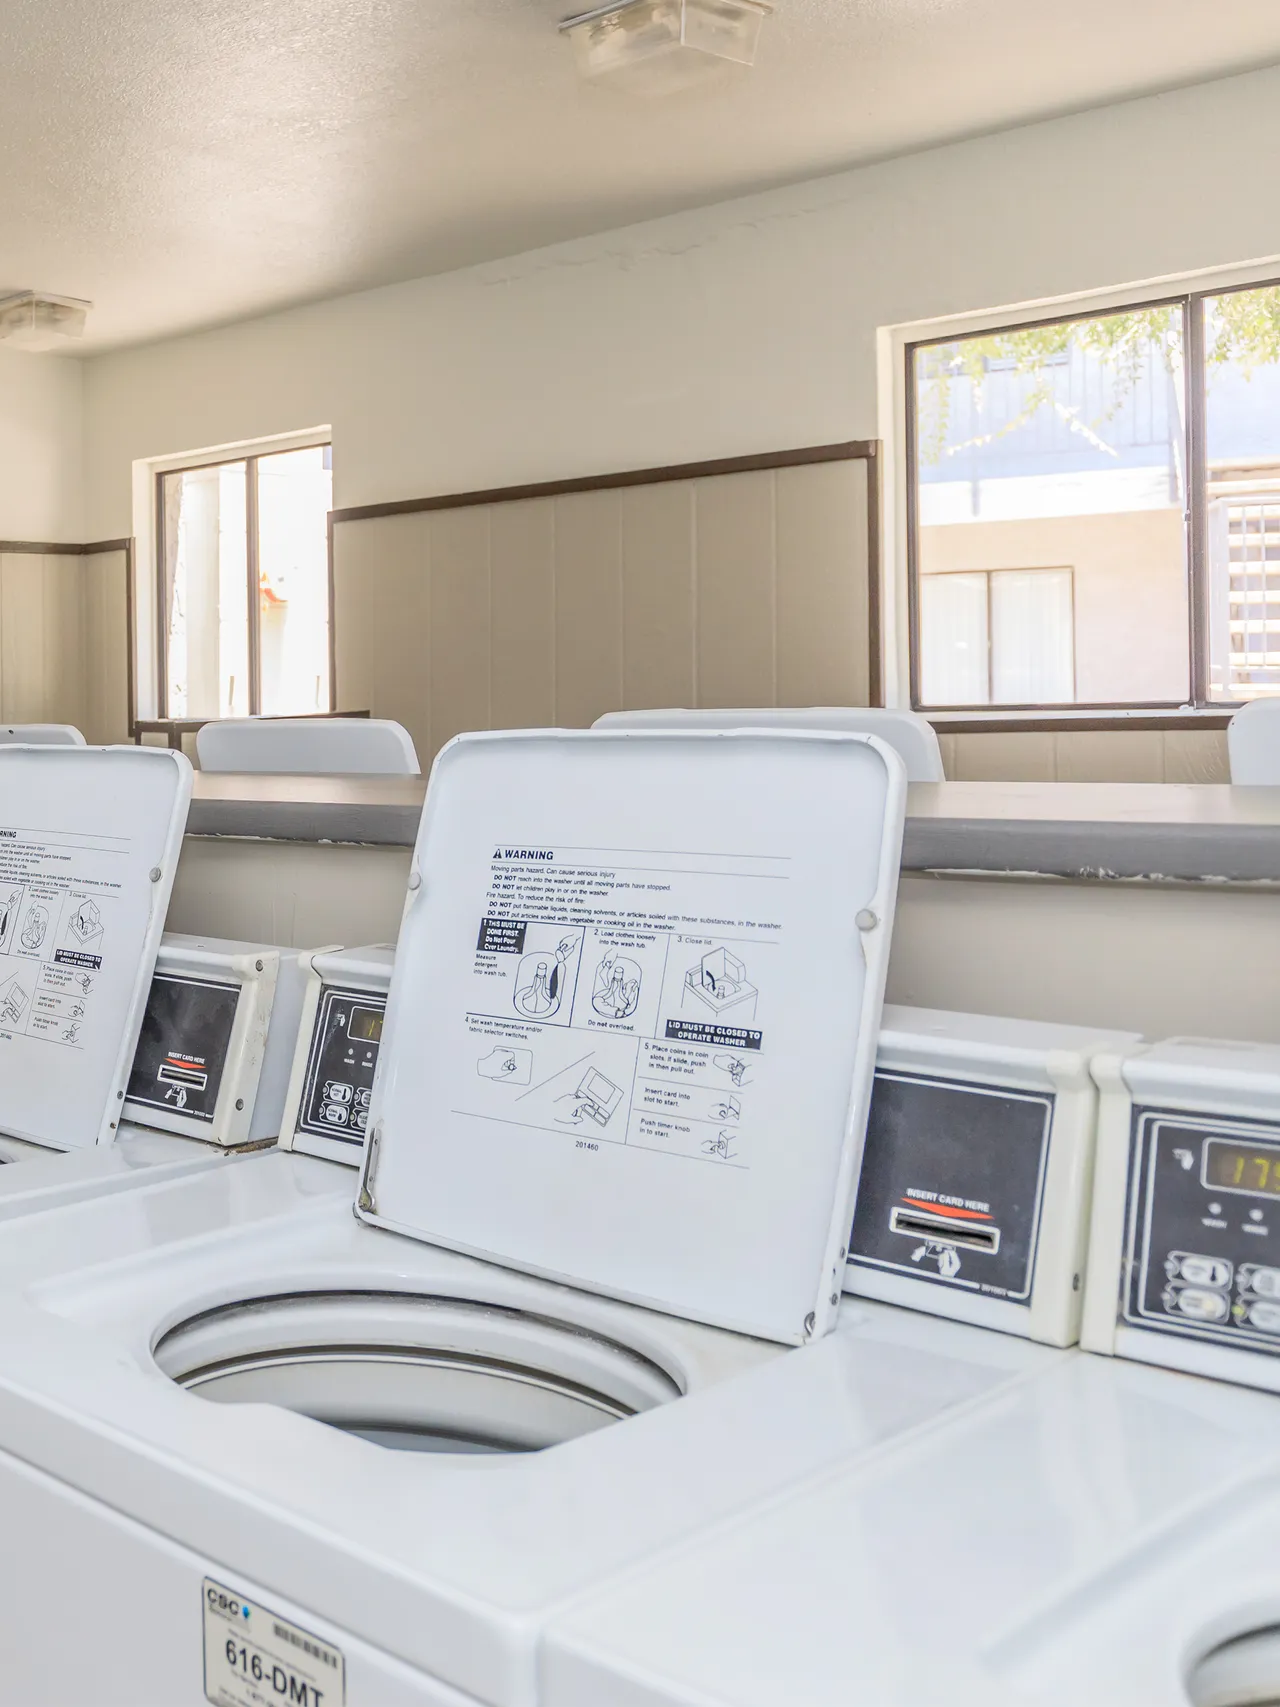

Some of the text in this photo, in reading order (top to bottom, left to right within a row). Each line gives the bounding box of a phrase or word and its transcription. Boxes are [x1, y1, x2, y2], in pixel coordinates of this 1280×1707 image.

[505, 849, 553, 860] WARNING
[490, 865, 510, 873] Moving
[682, 1022, 703, 1031] MUST
[716, 1027, 747, 1037] CLOSED
[677, 1031, 711, 1042] OPERATE
[644, 1087, 662, 1095] Insert
[640, 1118, 656, 1126] Push
[576, 1140, 598, 1151] 201460
[906, 1188, 990, 1212] INSERT CARD HERE
[207, 1588, 239, 1616] CSC
[226, 1640, 324, 1707] 616-DMT
